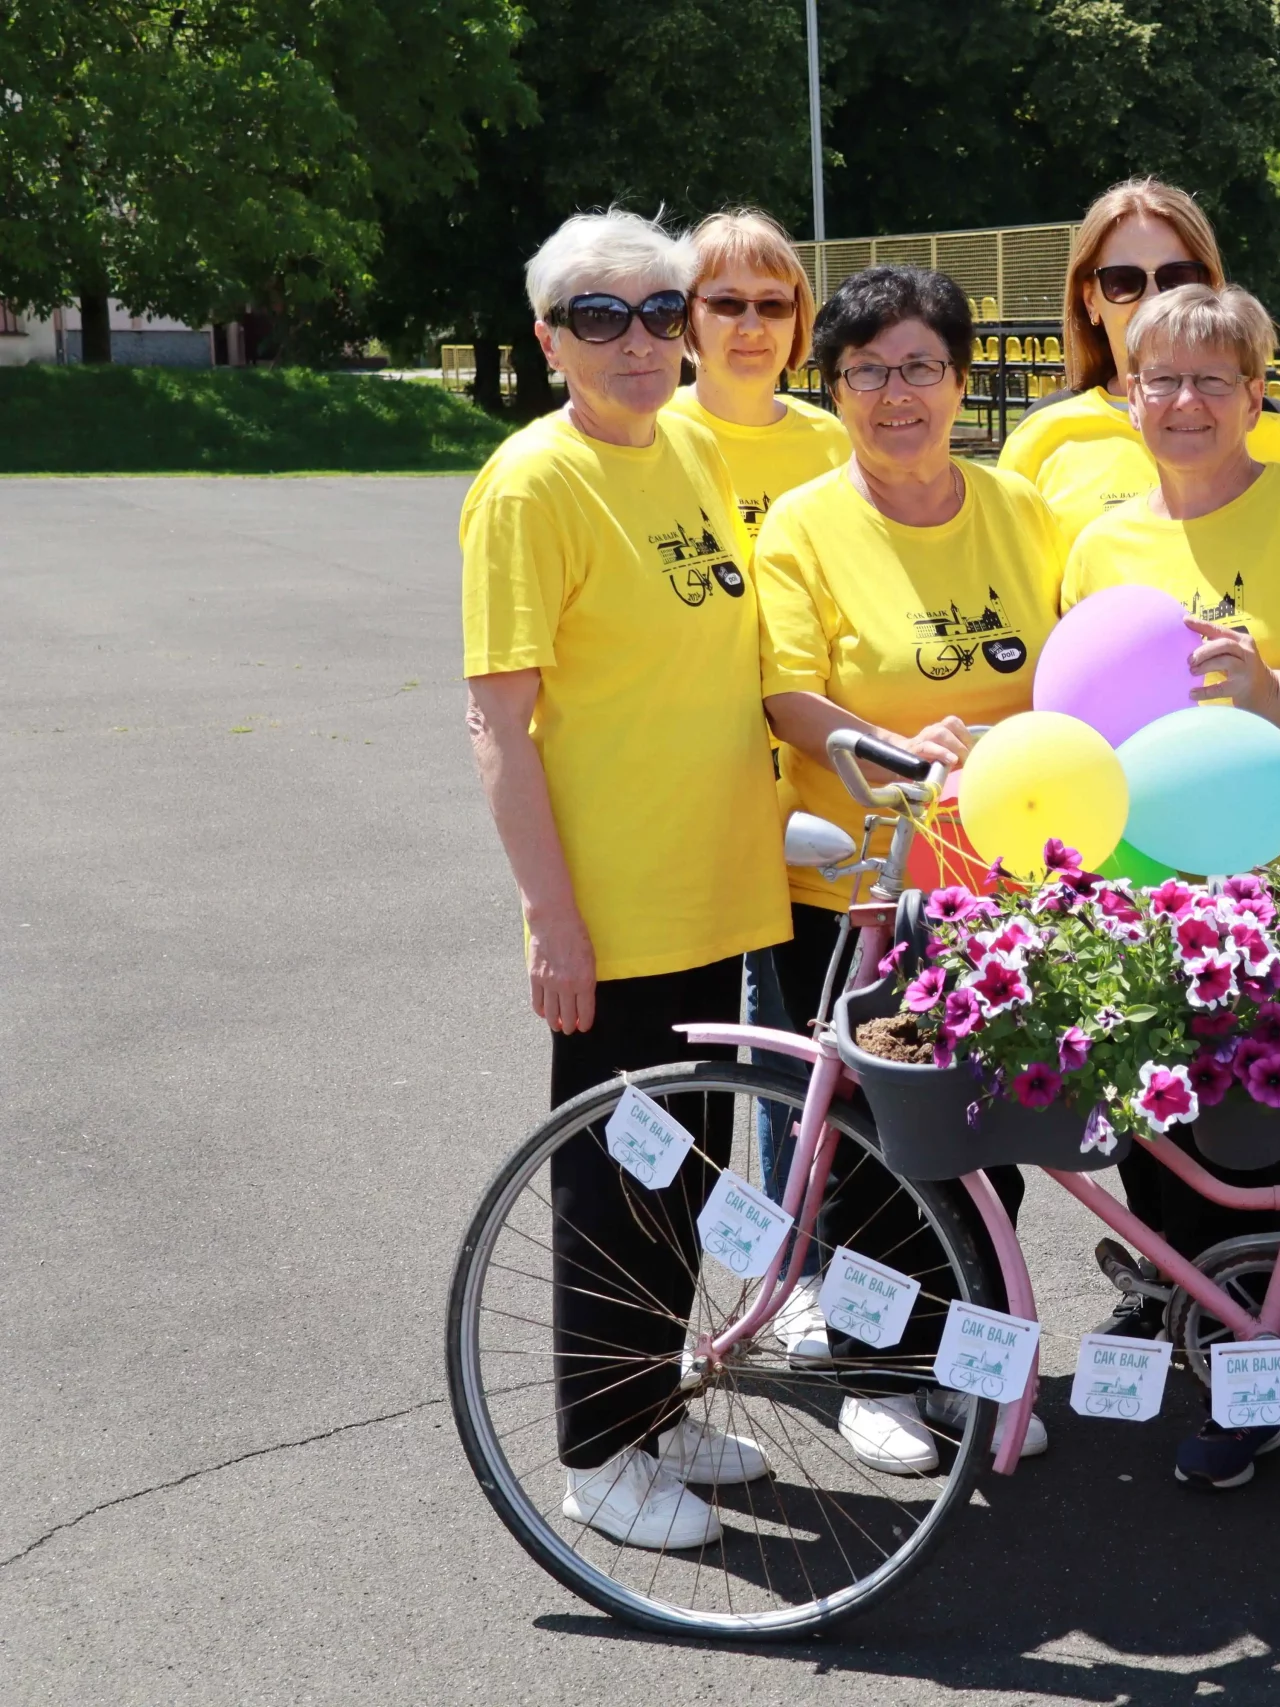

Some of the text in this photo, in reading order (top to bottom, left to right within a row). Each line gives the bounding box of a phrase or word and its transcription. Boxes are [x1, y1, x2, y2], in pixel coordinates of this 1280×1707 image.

[926, 610, 949, 618] BAJK
[1001, 650, 1016, 660] poli
[649, 1121, 674, 1148] BAJK
[745, 1205, 772, 1232] BAJK
[868, 1277, 898, 1301] BAJK
[987, 1326, 1018, 1348] BAJK
[1120, 1352, 1149, 1369] BAJK
[1253, 1356, 1280, 1372] BAJK
